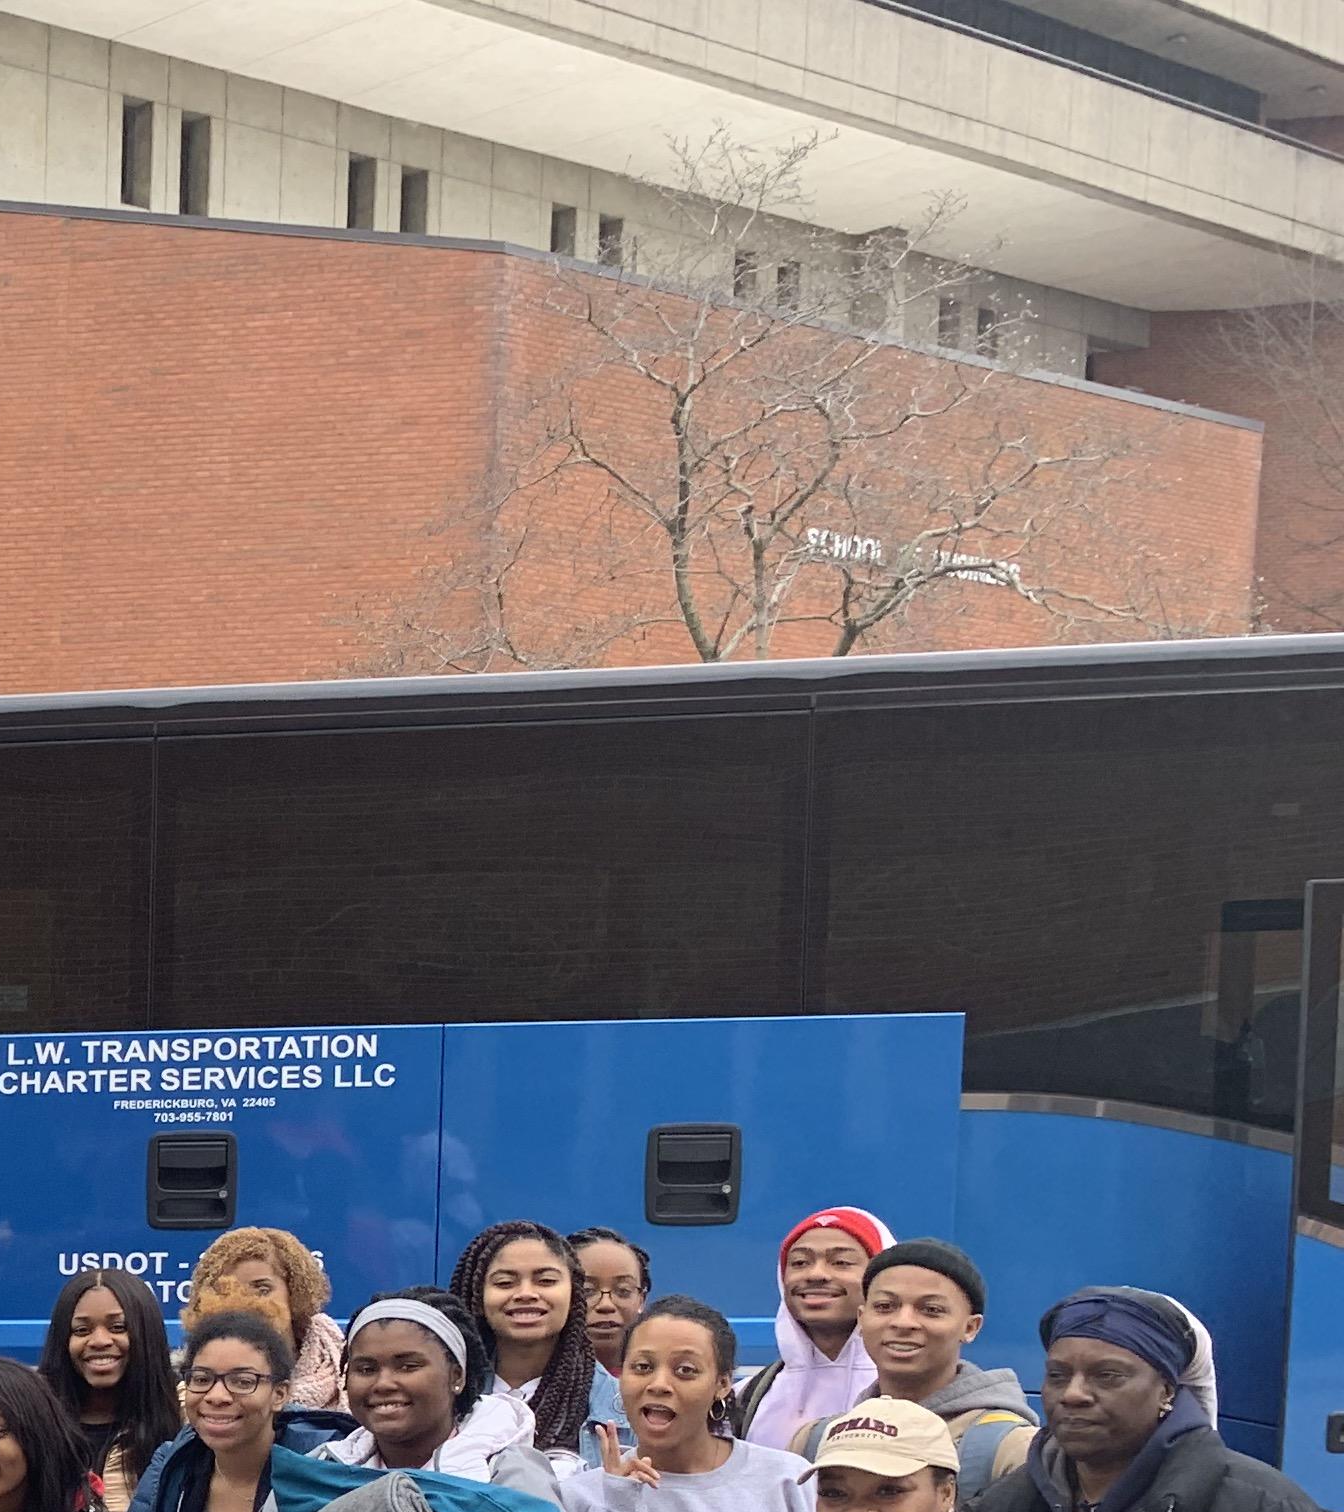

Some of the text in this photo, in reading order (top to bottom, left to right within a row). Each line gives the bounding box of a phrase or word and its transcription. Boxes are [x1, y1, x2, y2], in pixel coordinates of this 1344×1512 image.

[6, 1034, 379, 1067] L.W. TRANSPORTATION
[160, 1065, 323, 1092] SERVICES
[332, 1063, 397, 1089] LLC
[112, 1096, 277, 1111] FREDERICKBURG, VA 22405
[153, 1111, 235, 1123] 703-955-7801
[58, 1251, 169, 1277] USDOT
